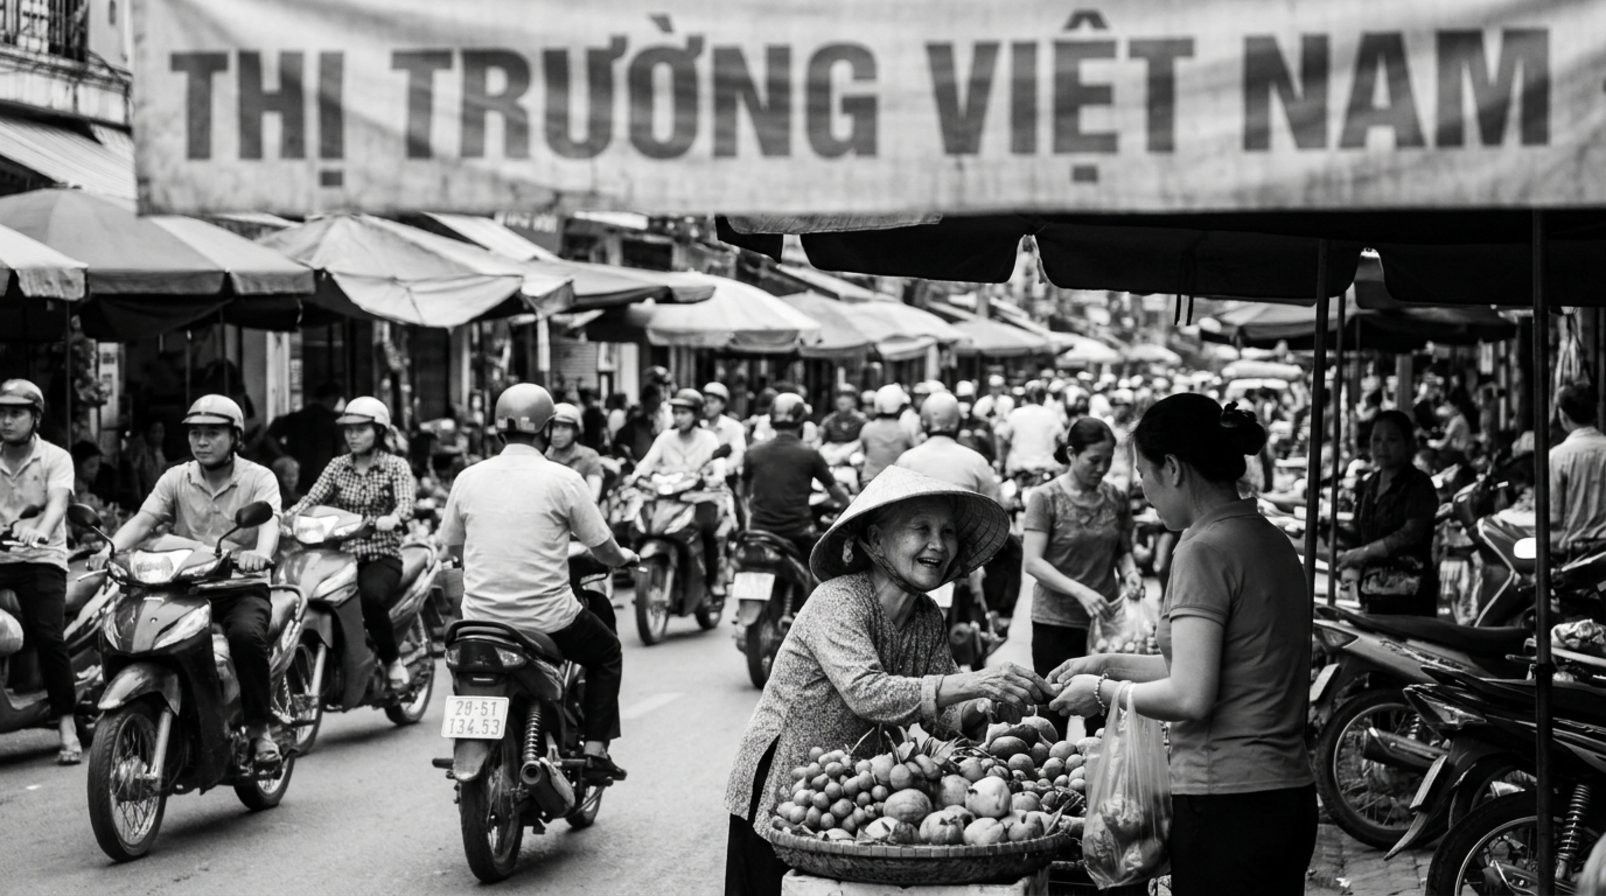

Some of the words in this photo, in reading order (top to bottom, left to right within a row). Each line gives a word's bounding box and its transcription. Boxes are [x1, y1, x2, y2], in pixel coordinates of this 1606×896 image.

[170, 50, 345, 188] THỊ
[393, 15, 878, 160] TRƯỜNG
[926, 10, 1193, 184] VIỆT
[1241, 27, 1553, 152] NAM
[449, 718, 500, 735] 134.53
